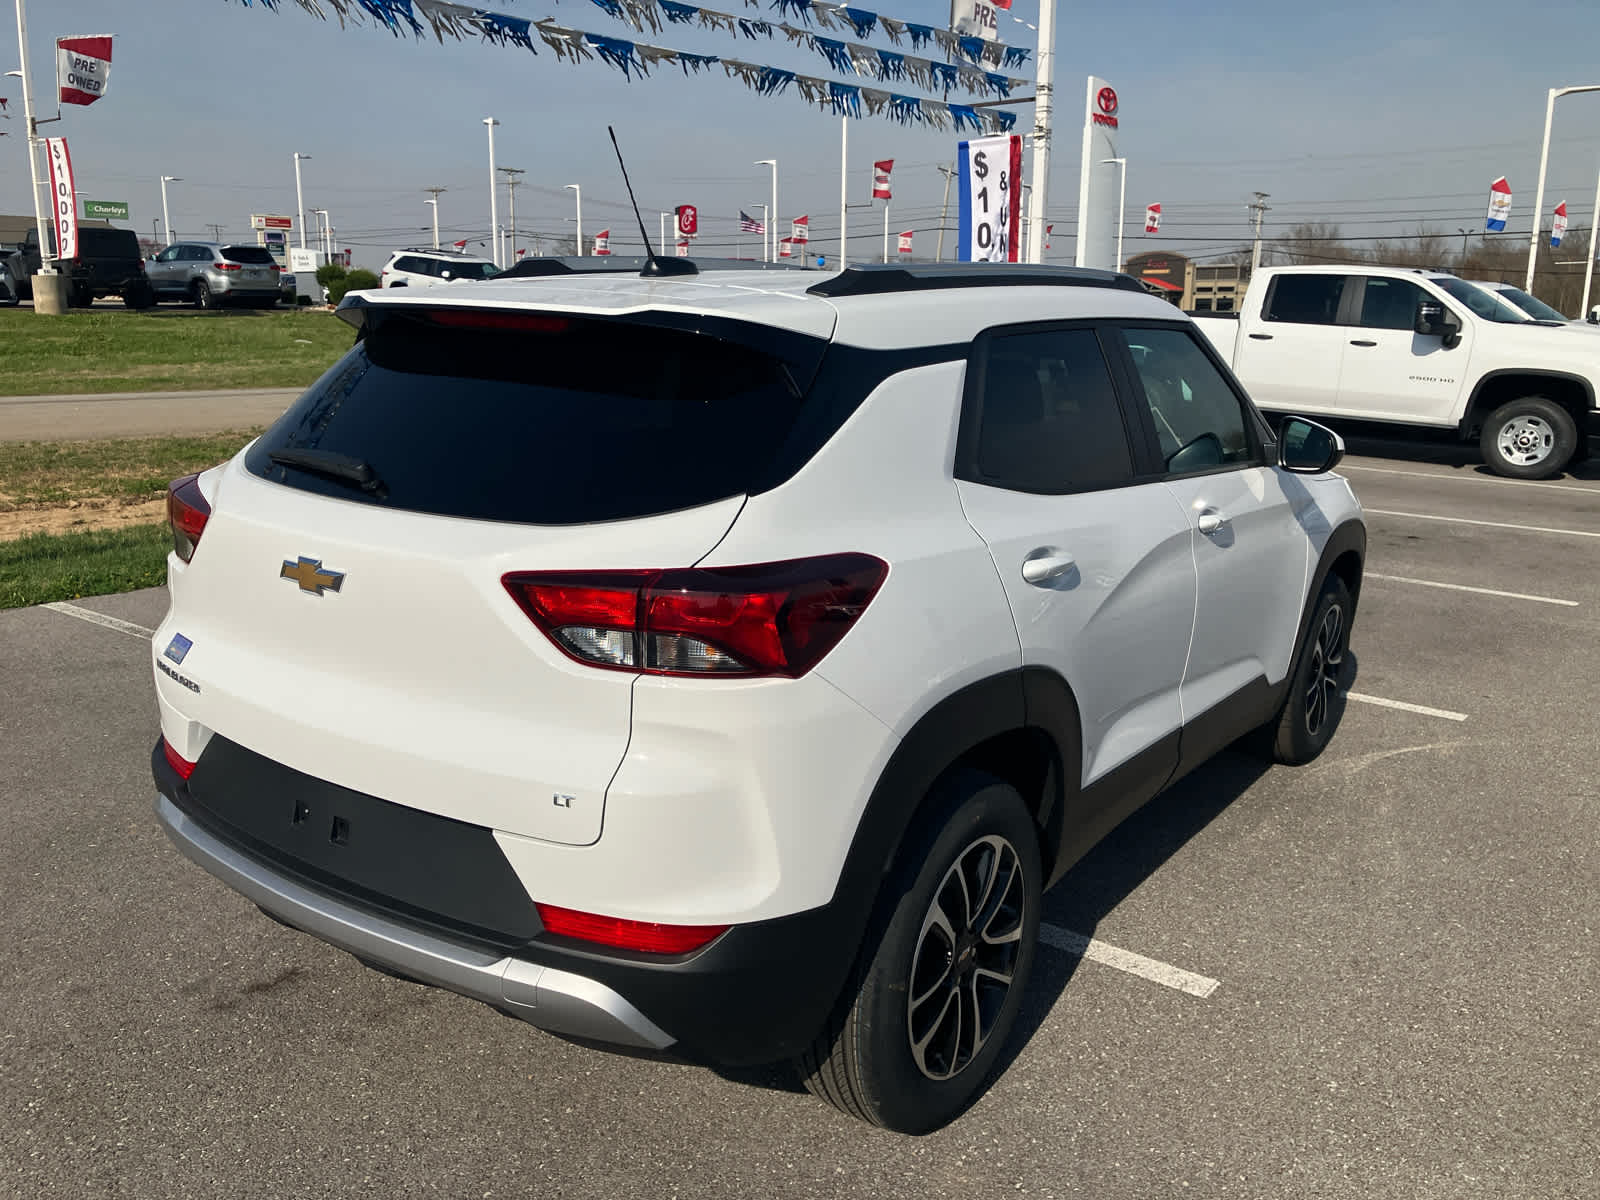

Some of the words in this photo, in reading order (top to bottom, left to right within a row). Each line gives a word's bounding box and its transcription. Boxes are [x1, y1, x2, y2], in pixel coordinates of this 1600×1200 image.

[973, 2, 998, 29] PRE
[73, 57, 97, 73] PRE
[67, 72, 101, 91] OWNED
[94, 205, 126, 214] Charleys
[553, 792, 576, 808] LT
